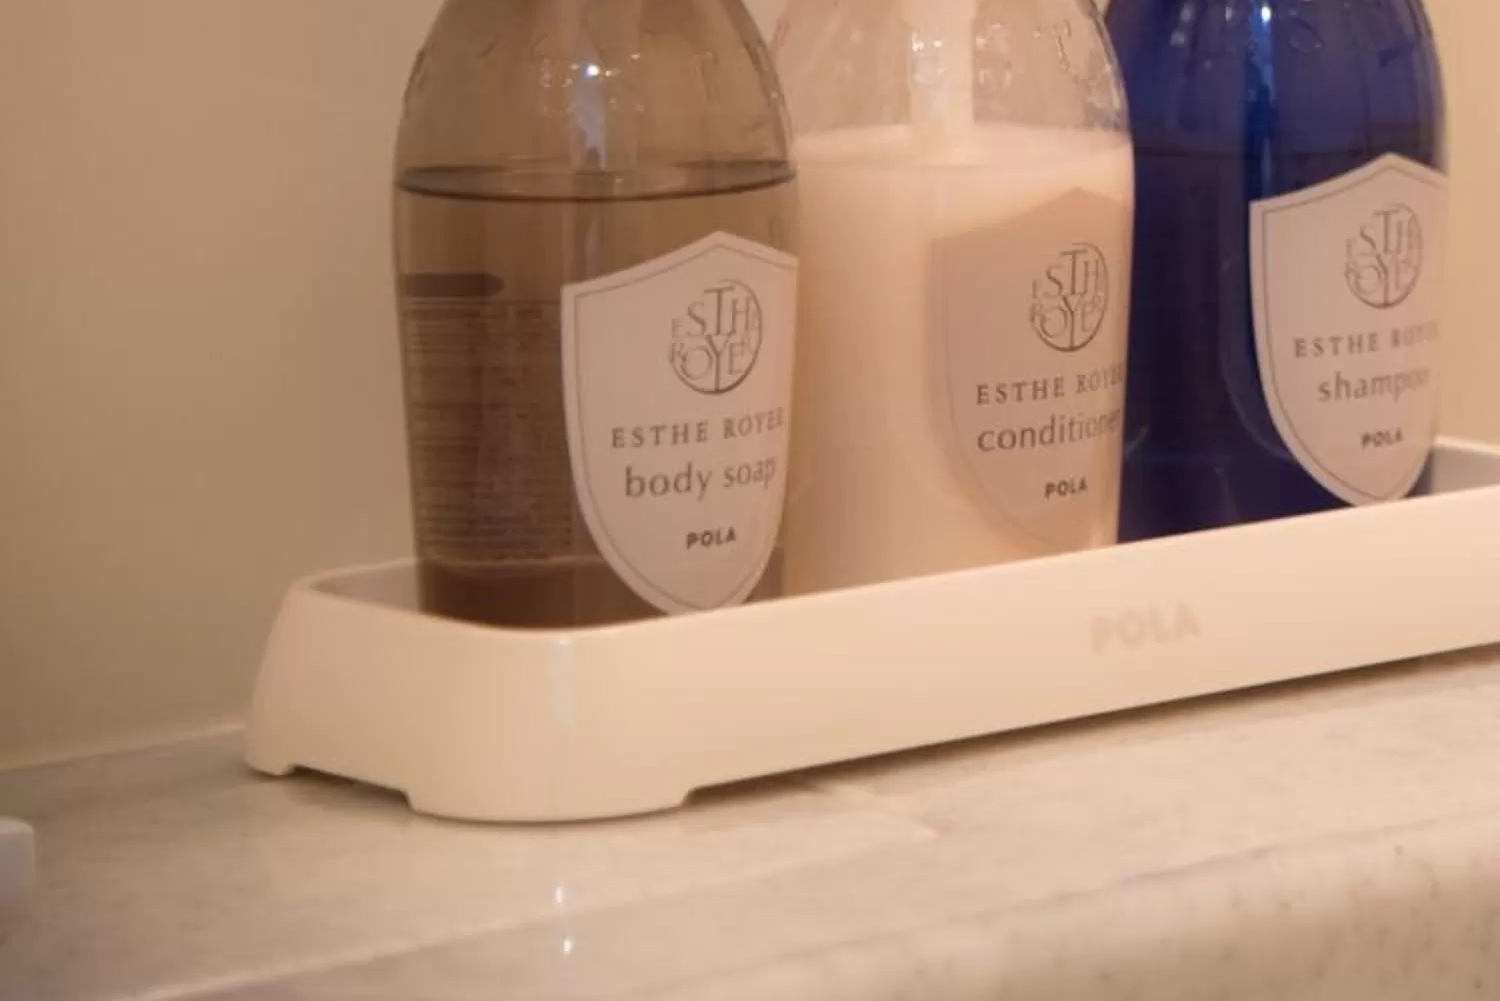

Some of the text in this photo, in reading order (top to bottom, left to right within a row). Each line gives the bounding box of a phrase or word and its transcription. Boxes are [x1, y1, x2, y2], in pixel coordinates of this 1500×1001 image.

[1293, 332, 1379, 359] ESTHE
[976, 376, 1065, 405] ESTHE
[611, 420, 710, 450] ESTHE
[1361, 426, 1403, 449] POLA
[624, 456, 777, 503] body soap
[1044, 477, 1088, 500] POLA
[685, 525, 737, 550] POLA
[1090, 601, 1201, 655] POLA
